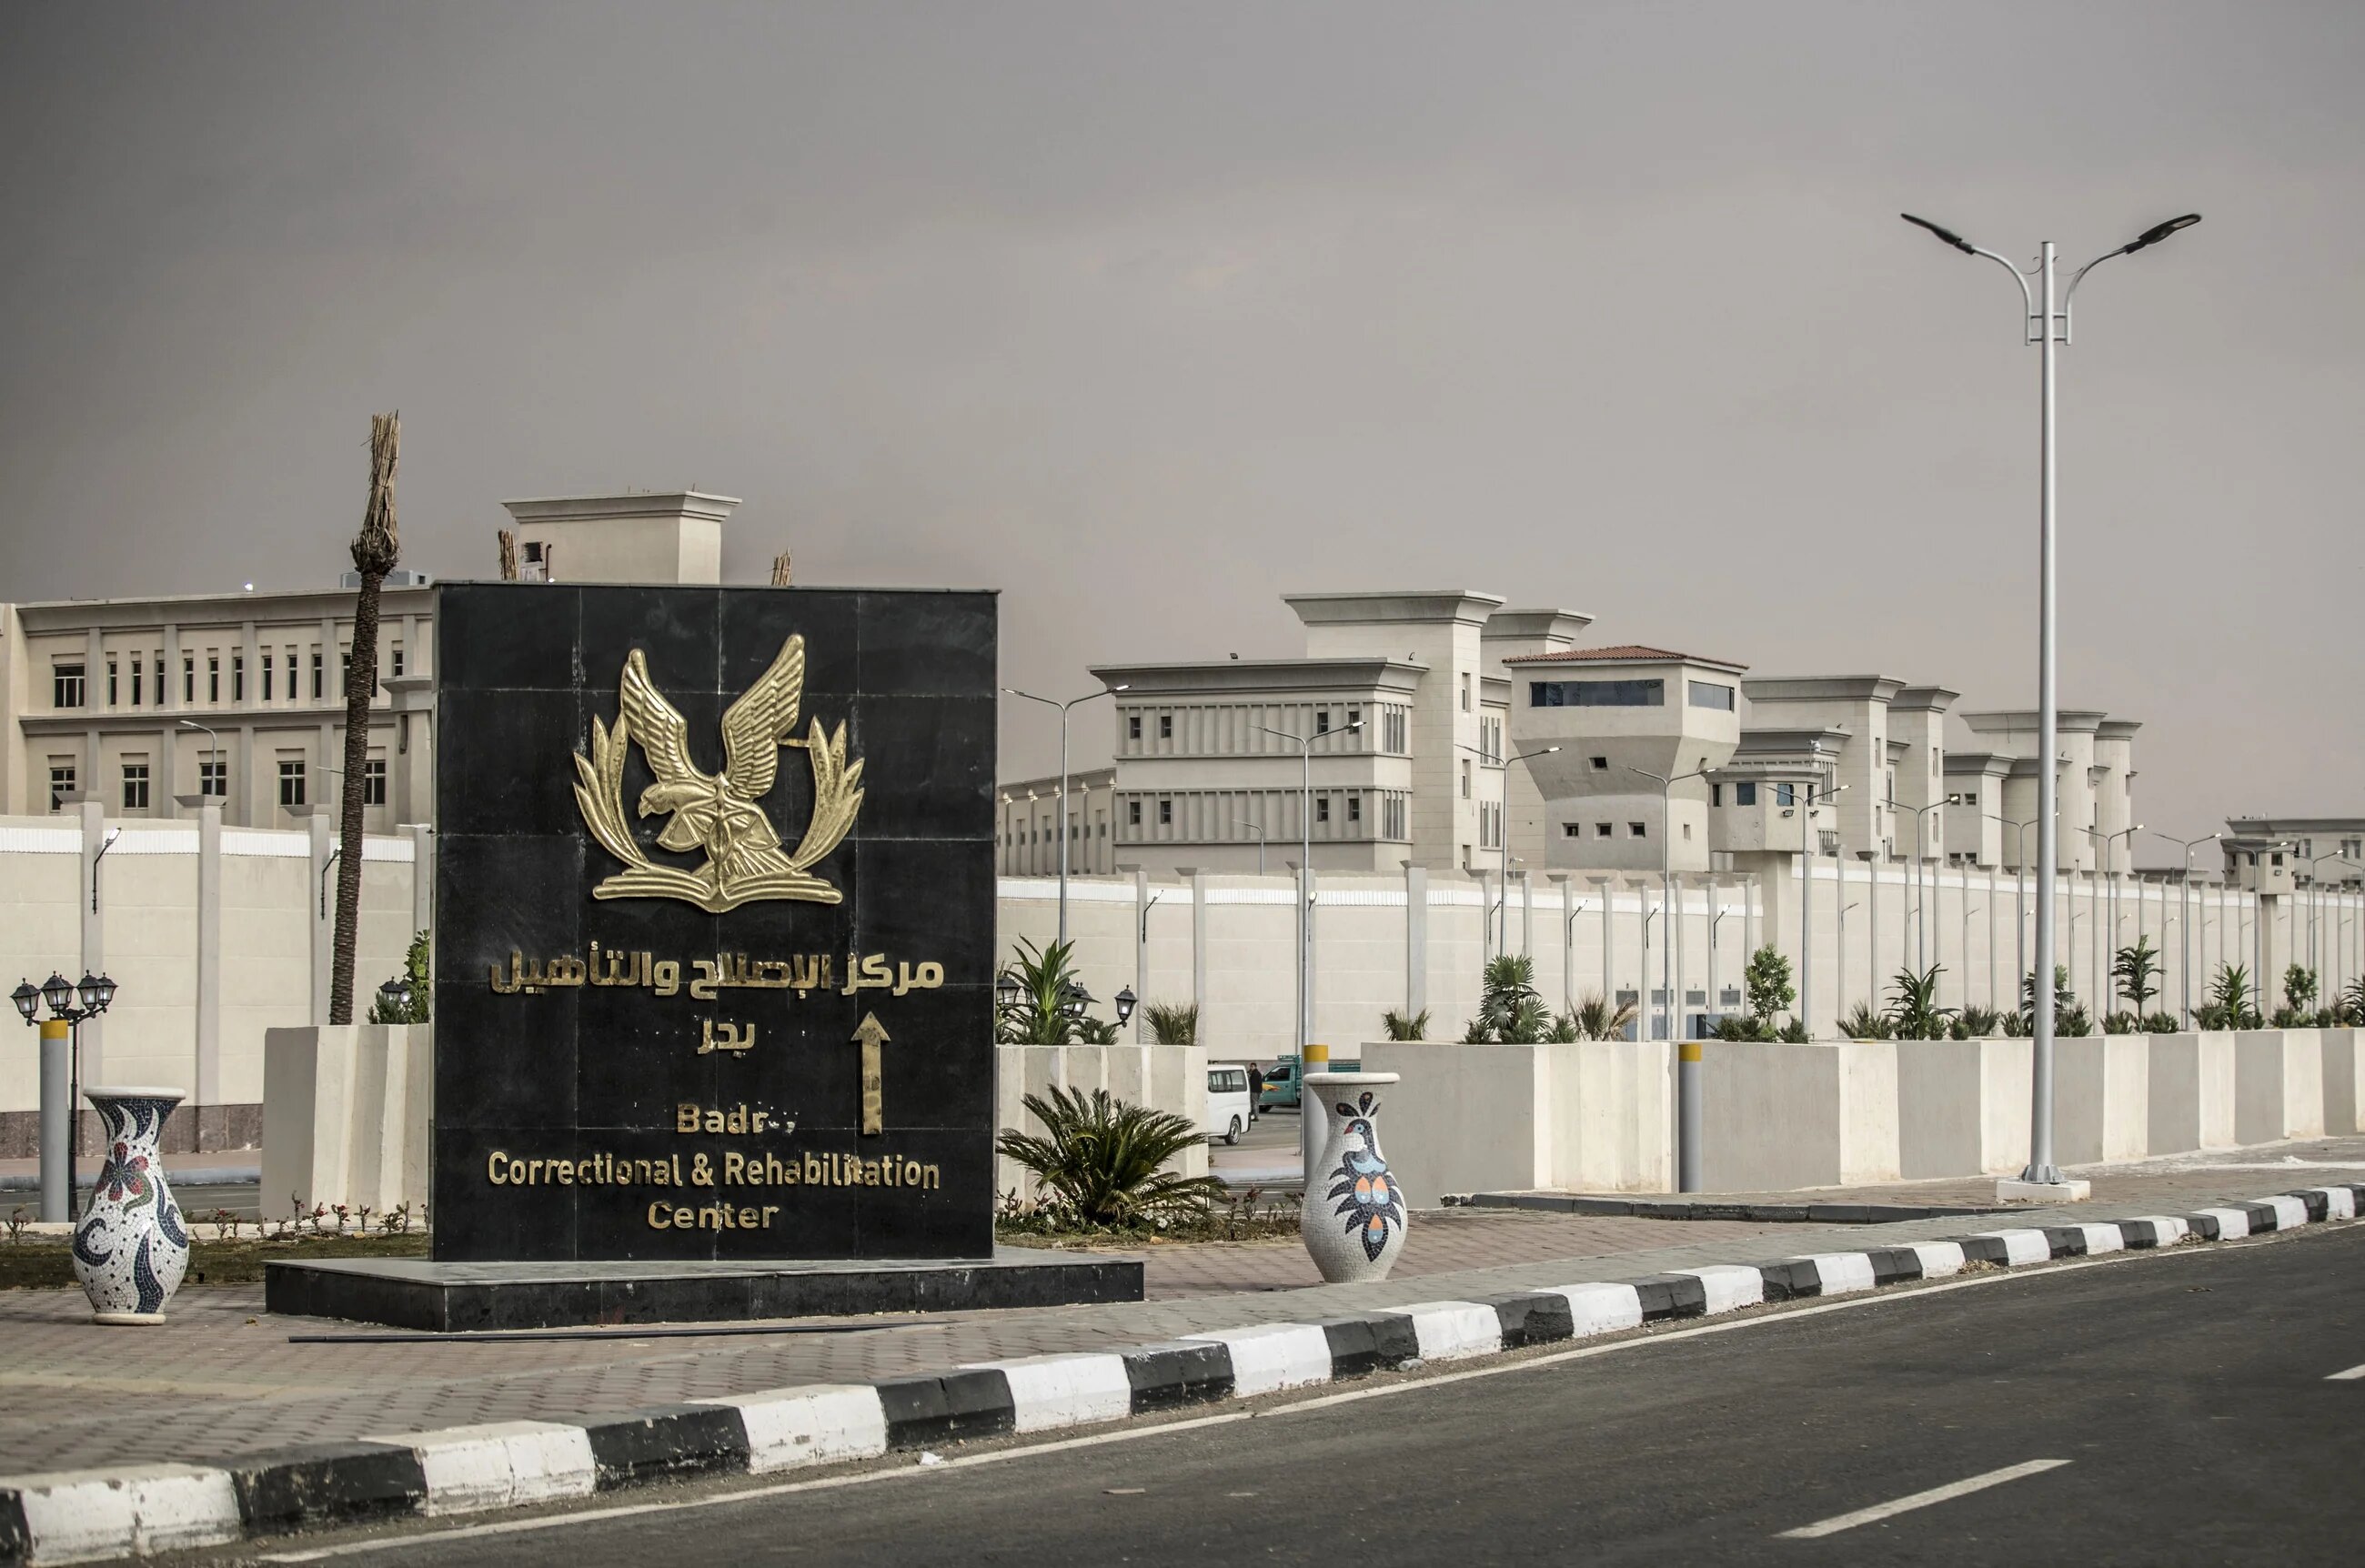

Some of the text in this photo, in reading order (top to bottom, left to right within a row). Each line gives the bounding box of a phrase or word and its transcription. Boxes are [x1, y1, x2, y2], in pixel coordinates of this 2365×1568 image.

[491, 940, 944, 1000] مركز الإصلاح والتأهيل
[697, 1018, 755, 1058] بدر
[677, 1102, 769, 1134] Badr
[488, 1151, 940, 1190] Correctional & Rehabilitation
[648, 1201, 780, 1230] Center
